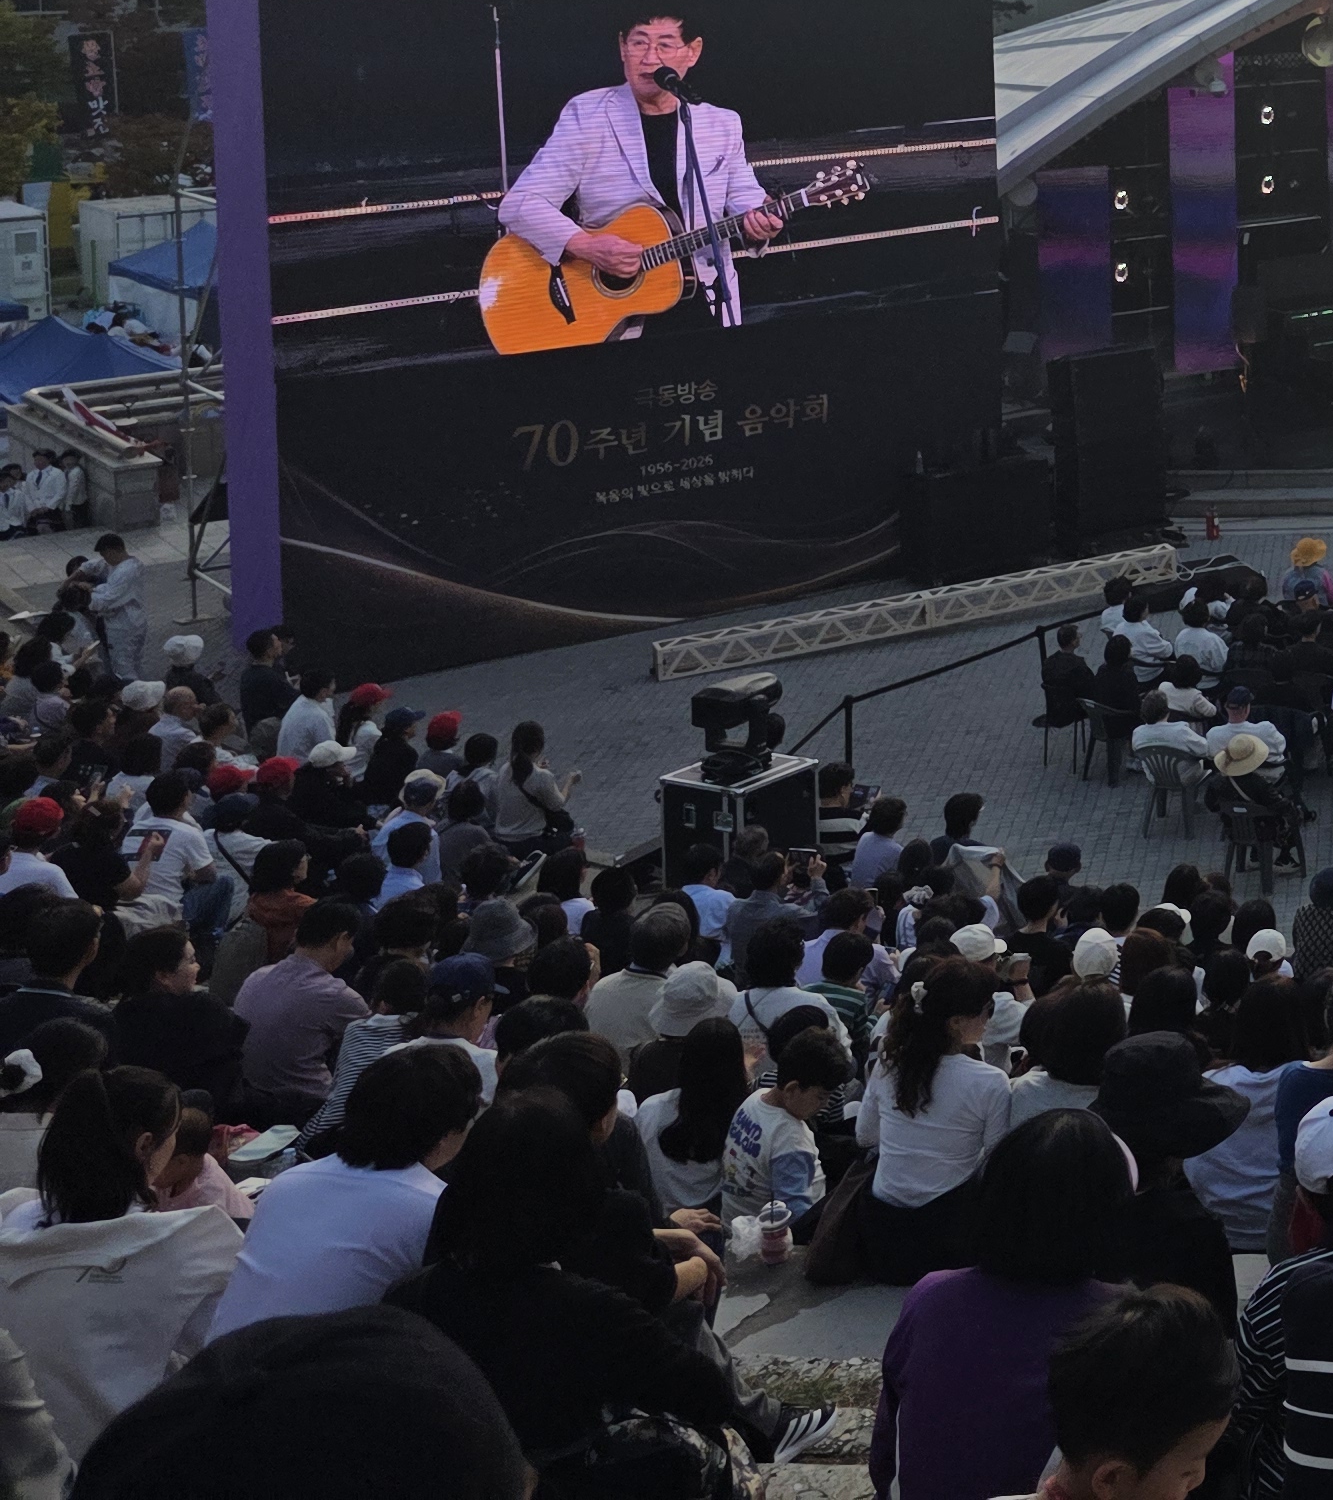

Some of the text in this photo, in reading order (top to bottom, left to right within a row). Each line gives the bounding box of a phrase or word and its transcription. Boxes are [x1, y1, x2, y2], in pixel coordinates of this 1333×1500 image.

[635, 379, 719, 408] 극동방송
[512, 394, 829, 471] 70주년 기념 음악회
[640, 454, 714, 478] 1956-2026
